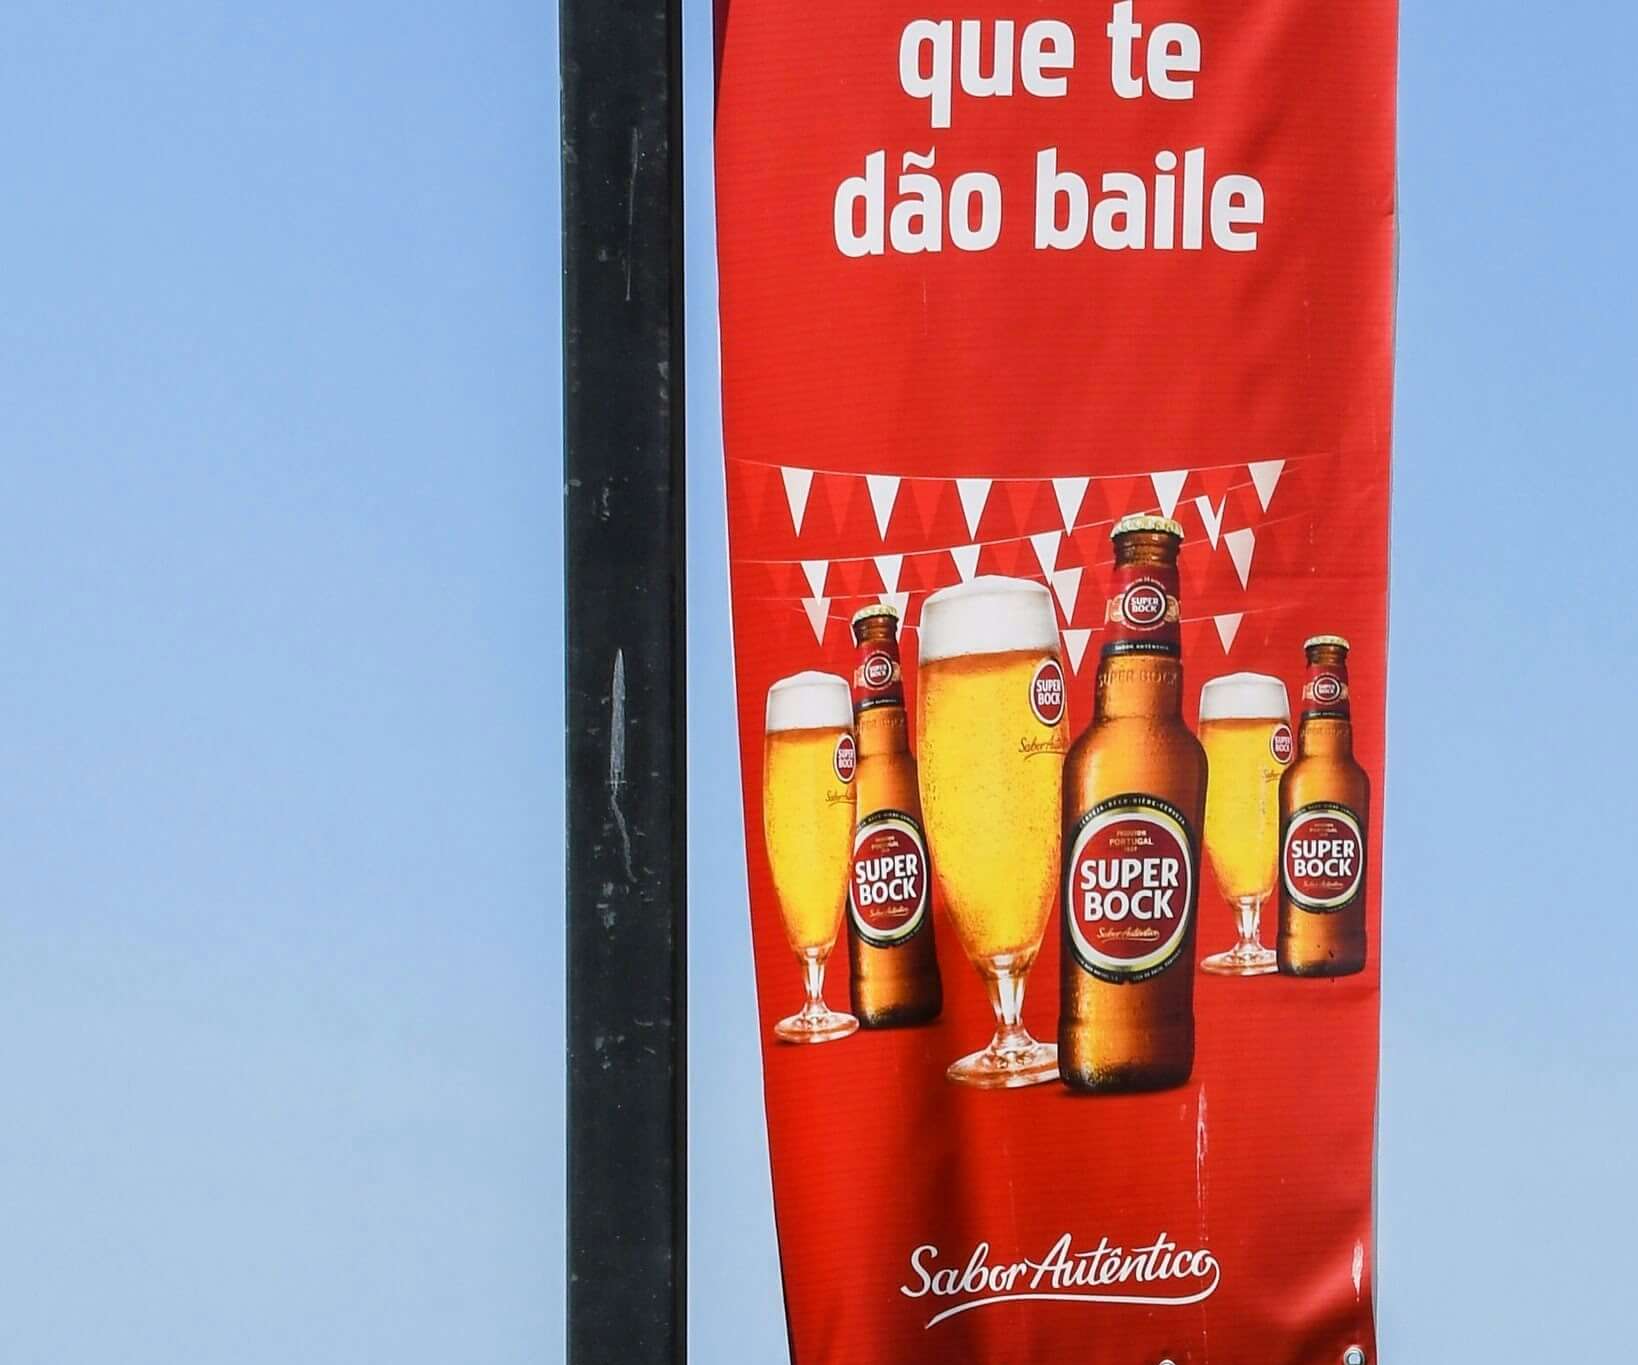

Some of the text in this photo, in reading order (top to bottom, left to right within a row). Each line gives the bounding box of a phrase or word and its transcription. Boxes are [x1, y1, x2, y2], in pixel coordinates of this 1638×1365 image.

[899, 0, 1201, 128] que te
[834, 146, 1265, 258] dão baile
[1036, 679, 1062, 692] SUPER
[1037, 693, 1061, 705] BOCK
[1291, 839, 1355, 858] SUPER
[855, 853, 918, 884] SUPER
[1080, 858, 1179, 890] SUPER
[1294, 858, 1352, 878] BOCK
[859, 876, 917, 906] BOCK
[1084, 889, 1174, 922] BOCK
[900, 1232, 1220, 1297] Sabor Autêntico
